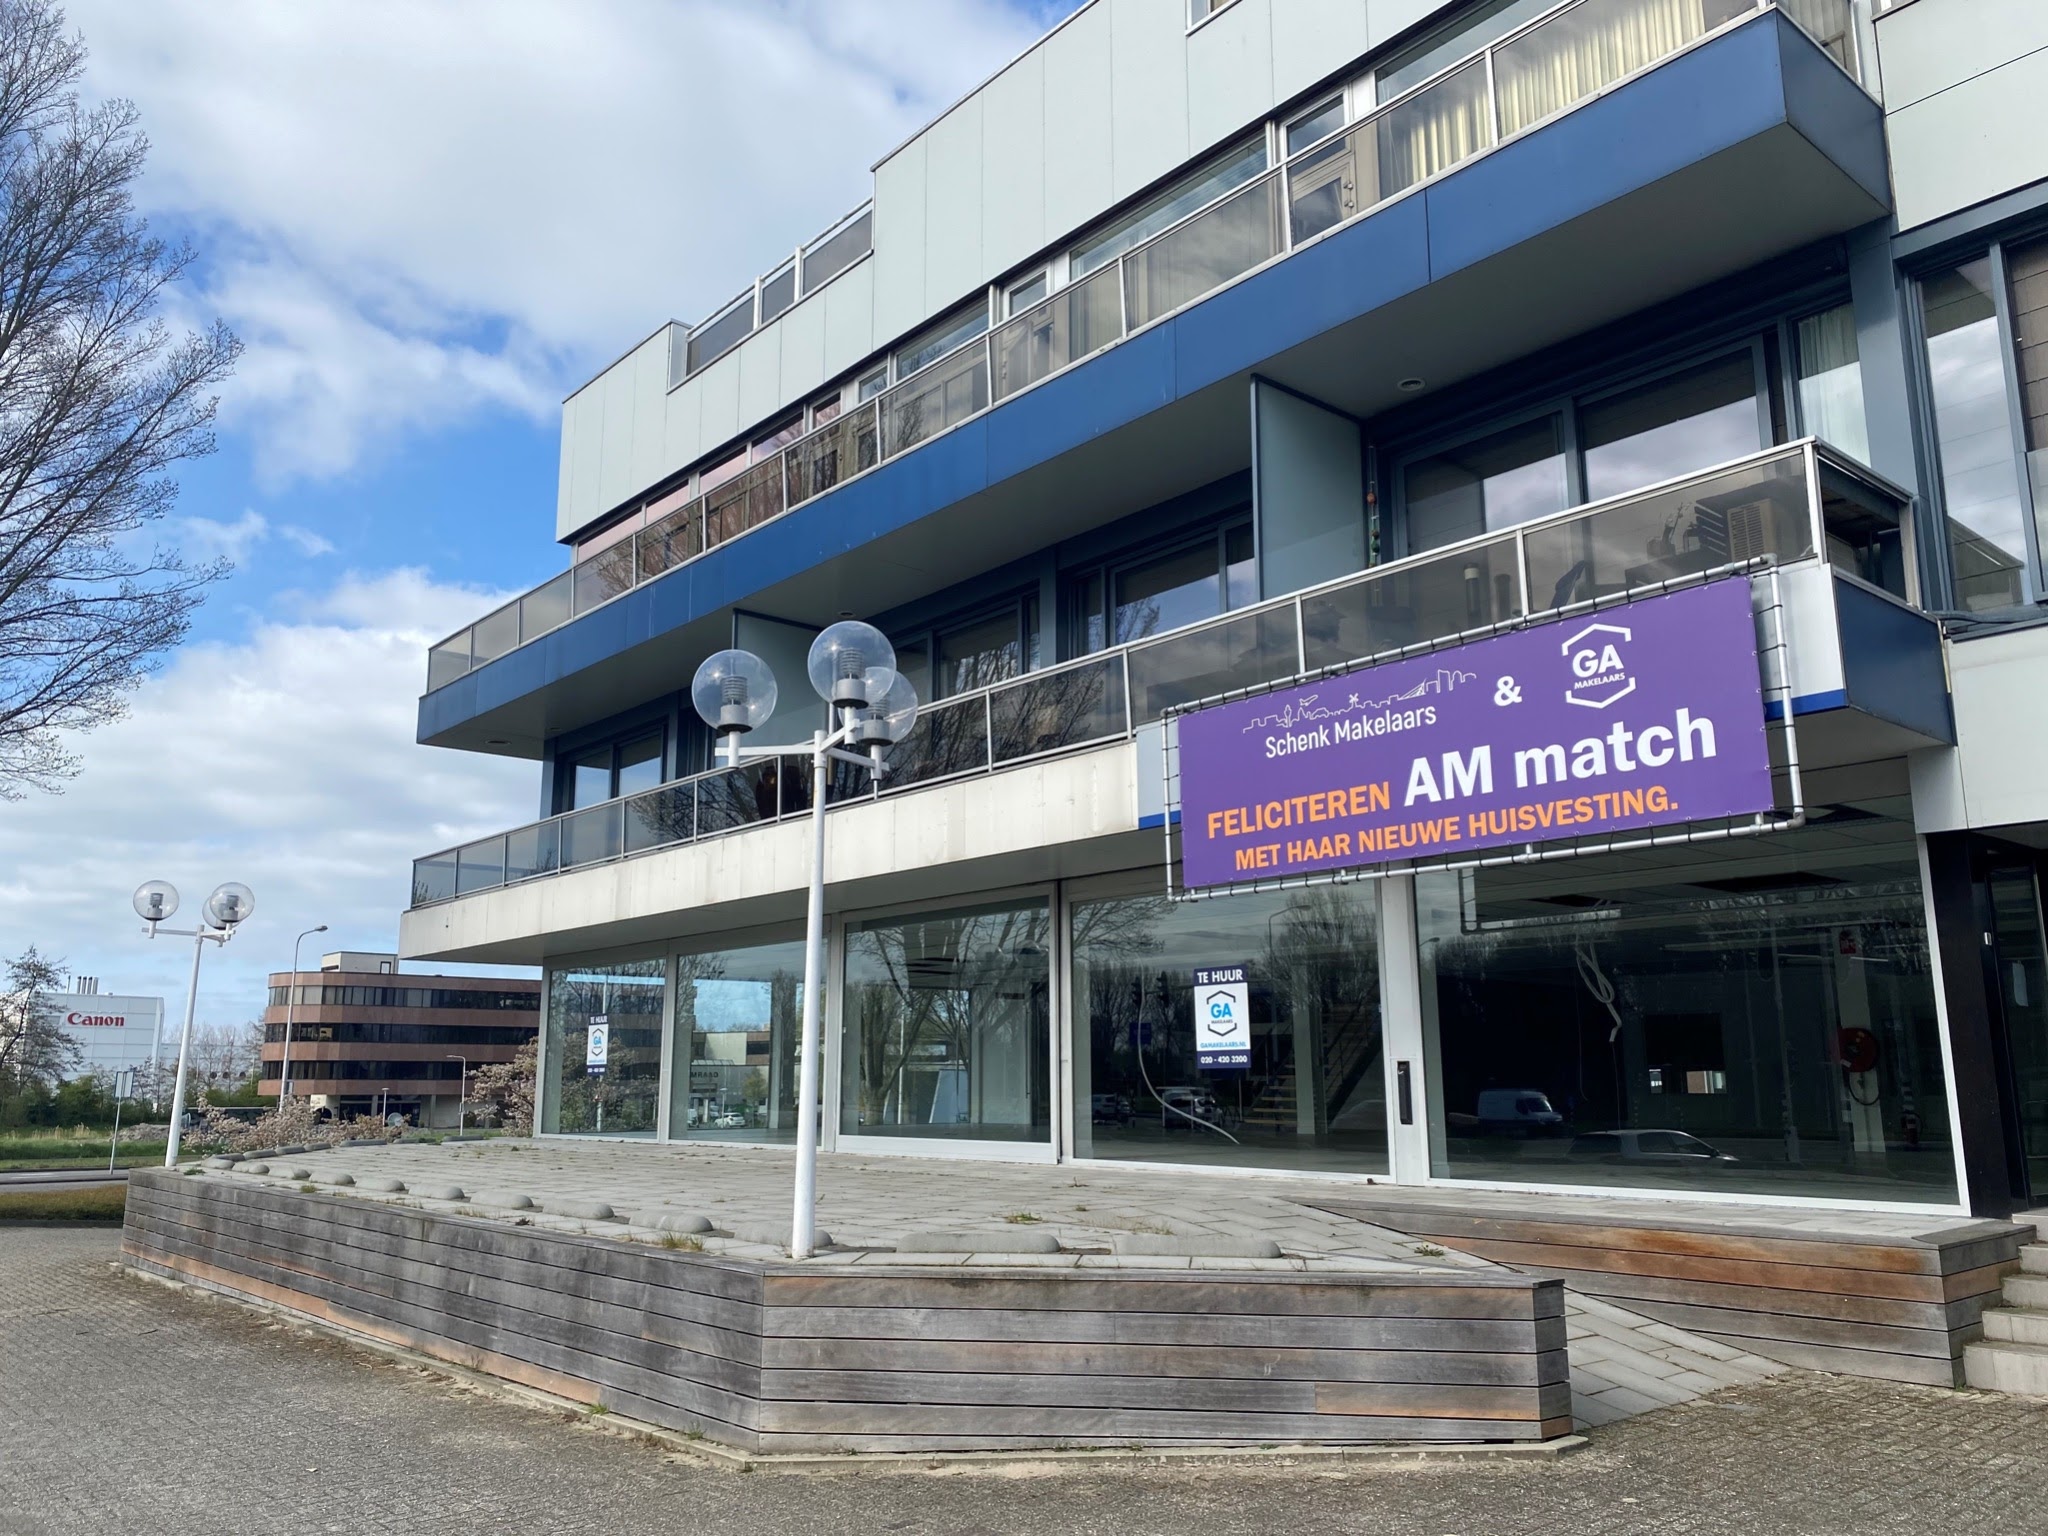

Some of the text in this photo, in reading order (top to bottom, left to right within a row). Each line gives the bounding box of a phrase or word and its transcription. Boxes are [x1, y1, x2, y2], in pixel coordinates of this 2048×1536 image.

[1572, 644, 1625, 678] GA
[1493, 676, 1523, 707] &
[1574, 672, 1626, 690] MAKELAARS
[1265, 705, 1437, 759] Schenk Makelaars
[1207, 707, 1717, 839] FELICITEREN AM match
[1235, 786, 1680, 871] MET HAAR NIEUWE HUISVESTING.
[1197, 969, 1243, 984] TE HUUR
[67, 1012, 125, 1027] Canon
[1210, 1003, 1232, 1019] GA
